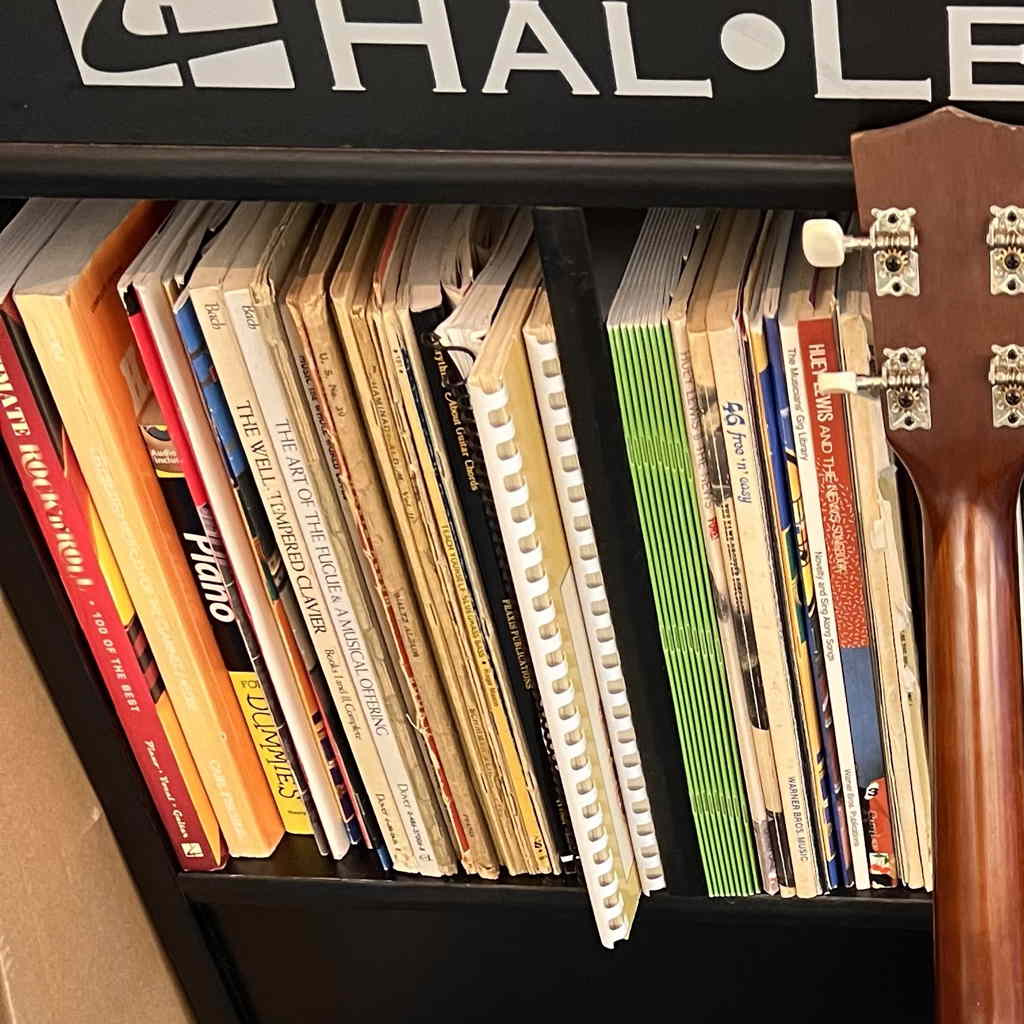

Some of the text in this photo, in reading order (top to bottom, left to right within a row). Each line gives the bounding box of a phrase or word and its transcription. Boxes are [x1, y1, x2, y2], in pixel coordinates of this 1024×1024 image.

[204, 301, 226, 329] Bach
[241, 302, 259, 330] Bach
[787, 347, 797, 364] The
[807, 342, 829, 375] HUEY
[810, 379, 835, 422] WIS
[275, 419, 298, 451] THE
[794, 414, 805, 429] Gig
[444, 391, 479, 491] About Guitar Chords
[793, 431, 808, 460] Library
[819, 424, 833, 454] AND
[286, 456, 308, 484] ART
[727, 429, 747, 455] free
[738, 476, 752, 504] easy
[821, 456, 837, 482] THE
[297, 487, 315, 506] OF
[0, 352, 32, 437] MATE
[92, 611, 108, 635] 100
[102, 638, 117, 654] OF
[111, 657, 127, 679] THE
[120, 684, 140, 712] BEST
[236, 400, 261, 437] THE
[296, 574, 327, 634] CLAVIER
[305, 511, 326, 542] THE
[183, 532, 235, 622] Piano
[315, 545, 342, 593] FUGUE
[814, 550, 825, 580] Novelty
[817, 581, 827, 595] and
[334, 604, 351, 621] A
[819, 597, 829, 615] Sing
[822, 615, 831, 636] Along
[324, 648, 340, 673] Books
[339, 619, 368, 675] MUSICAL
[510, 630, 532, 689] PUBLICATIONS
[825, 638, 835, 661] Songs
[359, 677, 389, 736] OFFERING
[788, 776, 801, 809] WARNER
[796, 836, 809, 862] MUSIC
